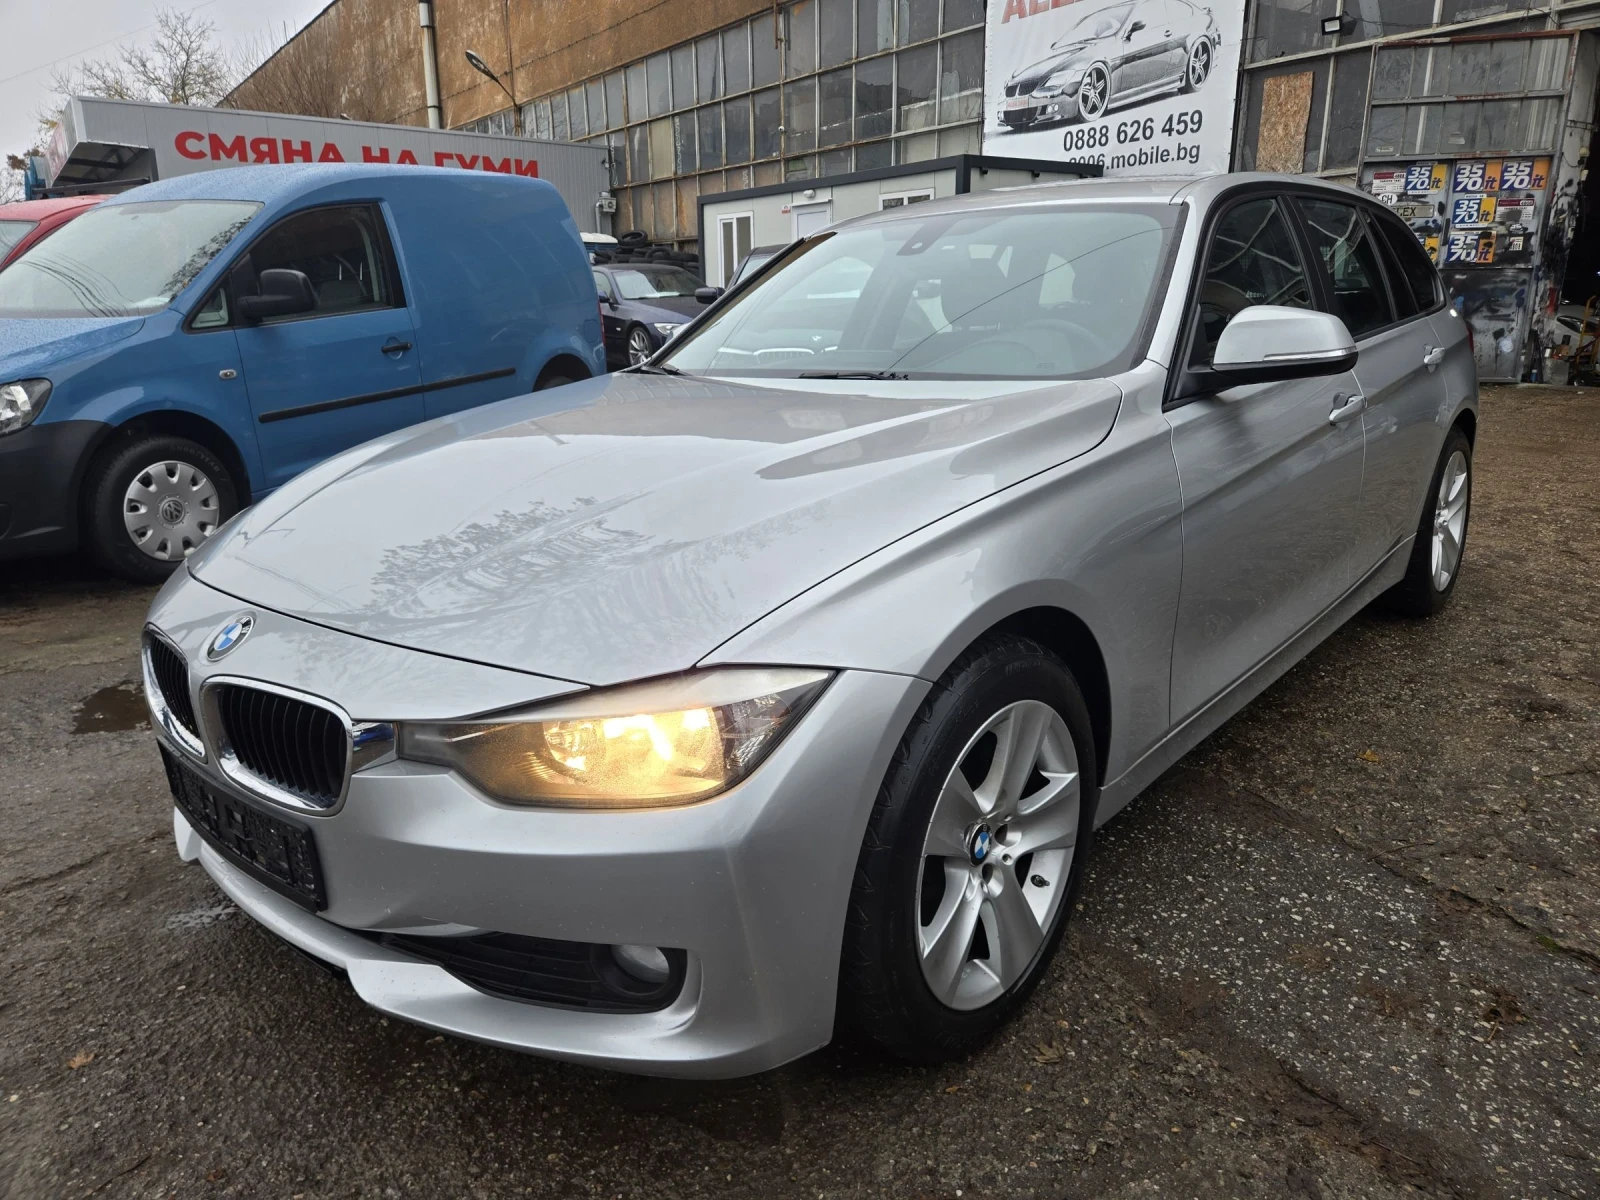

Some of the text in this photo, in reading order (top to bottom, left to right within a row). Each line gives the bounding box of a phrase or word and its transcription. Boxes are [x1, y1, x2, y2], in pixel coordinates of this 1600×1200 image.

[1063, 109, 1203, 152] 0888 626 459
[174, 131, 539, 179] СМЯНА НА ГУМИ
[1407, 166, 1431, 178] 35
[1457, 164, 1484, 178] 35
[1503, 162, 1532, 176] 35
[1381, 194, 1393, 204] CH
[1455, 199, 1480, 212] 35
[1392, 207, 1416, 217] LEX
[1450, 235, 1478, 249] 35
